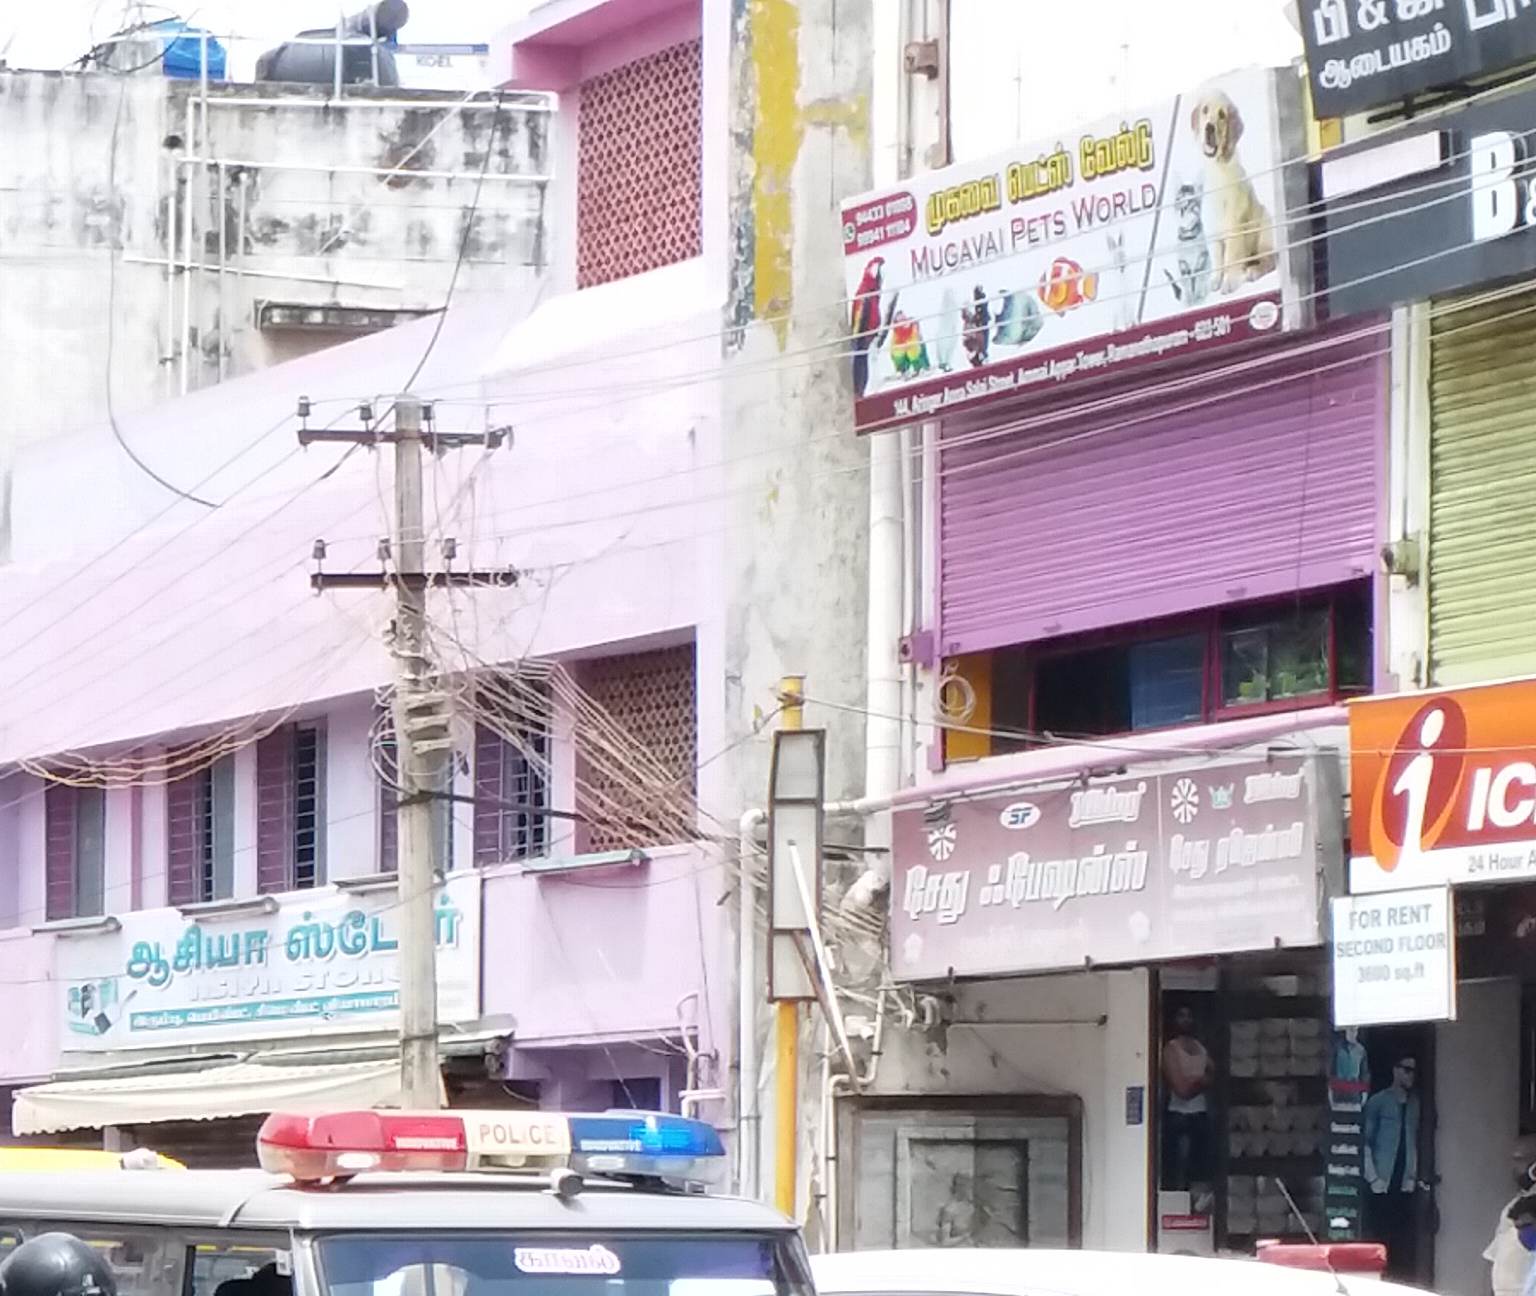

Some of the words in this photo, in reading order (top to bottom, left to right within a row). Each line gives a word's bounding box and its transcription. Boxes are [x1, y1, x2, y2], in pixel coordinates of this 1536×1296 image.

[1319, 22, 1452, 89] ஆடையகம்
[924, 174, 1001, 237] முகவை
[1006, 142, 1074, 204] பெட்ஸ்
[1079, 119, 1156, 182] வேல்டு
[910, 227, 1006, 280] MUGAVAI
[1010, 209, 1066, 250] PETS
[1070, 183, 1158, 230] WORLD
[1488, 852, 1524, 872] Hour
[903, 864, 971, 925] சேது
[1349, 910, 1381, 931] FOR
[1387, 903, 1433, 927] RENT
[126, 921, 272, 988] ஆசியா
[1336, 937, 1394, 958] SECOND
[1399, 932, 1447, 953] FLOOR
[479, 1123, 558, 1145] POLICE
